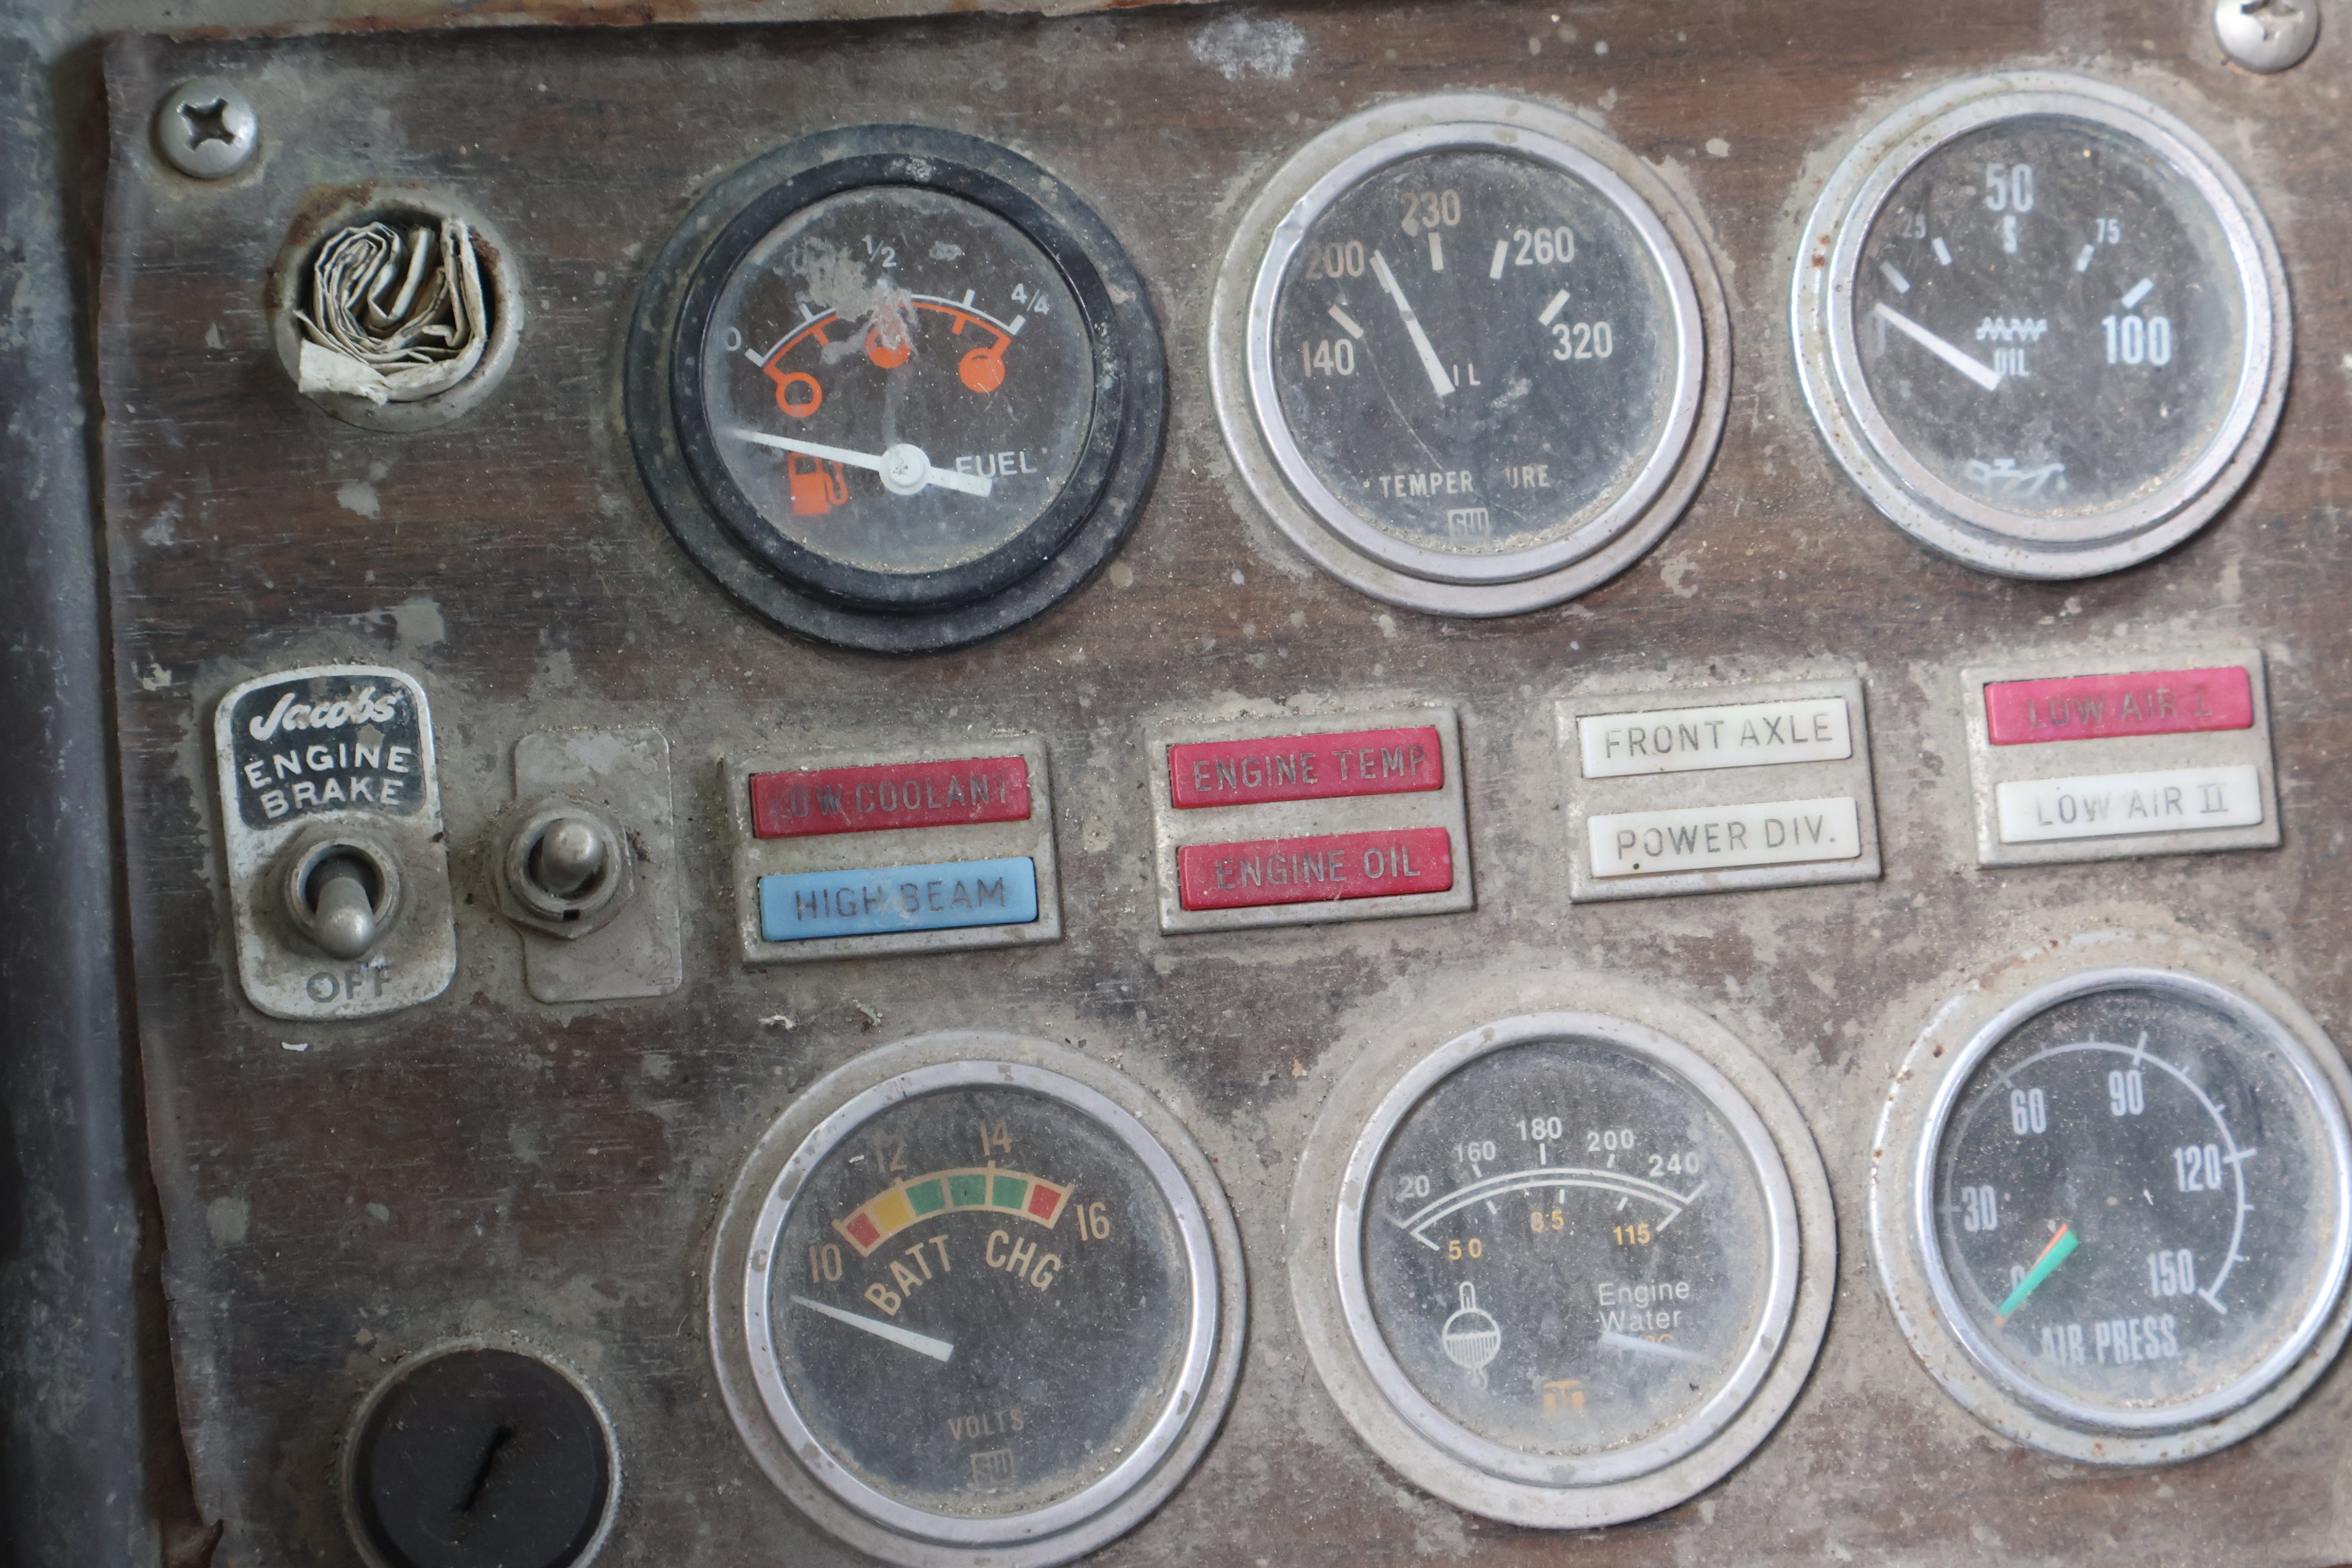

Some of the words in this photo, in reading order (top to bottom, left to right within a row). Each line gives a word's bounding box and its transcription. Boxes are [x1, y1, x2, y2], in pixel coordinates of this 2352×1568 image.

[1985, 163, 2034, 212] 50
[862, 236, 897, 268] 1/2
[1514, 226, 1576, 266] 260
[1011, 283, 1051, 316] 4/4
[1303, 338, 1356, 378] 140
[1553, 321, 1613, 361] 320
[2102, 314, 2171, 366] 100
[1995, 347, 2031, 377] OIL
[955, 450, 1038, 479] FUEL
[2027, 694, 2103, 728] LOW
[2120, 688, 2177, 722] AIR
[1605, 720, 1724, 758] FRONT
[1740, 713, 1833, 747] AXLE
[244, 743, 412, 789] ENGINE
[1194, 753, 1318, 791] ENGINE
[1333, 745, 1425, 780] TEMP
[260, 777, 403, 818] BRAKE
[856, 774, 1008, 813] COOLANT
[2038, 792, 2111, 826] LOW
[2128, 786, 2183, 818] AIR
[1617, 821, 1747, 860] POWER
[1764, 815, 1836, 848] DIV.
[1216, 850, 1346, 889] ENGINE
[1364, 846, 1420, 879] OIL
[796, 886, 885, 921] HIGH
[900, 877, 1005, 915] BEAM
[2011, 1089, 2047, 1136] 60
[2108, 1071, 2144, 1116] 90
[980, 1120, 1013, 1156] 14
[1516, 1116, 1562, 1141] 180
[1586, 1129, 1635, 1152] 200
[1454, 1140, 1496, 1163] 160
[1648, 1154, 1700, 1176] 240
[2174, 1143, 2221, 1192] 120
[1076, 1201, 1110, 1242] 16
[1963, 1185, 1997, 1232] 30
[1448, 1238, 1483, 1260] 50
[1612, 1223, 1651, 1245] 115
[809, 1243, 843, 1284] 10
[864, 1234, 955, 1317] BATT
[985, 1229, 1062, 1293] CHG
[2148, 1249, 2195, 1297] 150
[1599, 1279, 1690, 1308] Engine
[1600, 1310, 1681, 1332] Water
[2040, 1323, 2085, 1366] AIR
[2096, 1314, 2178, 1363] PRESS
[948, 1410, 1025, 1441] VOLTS
